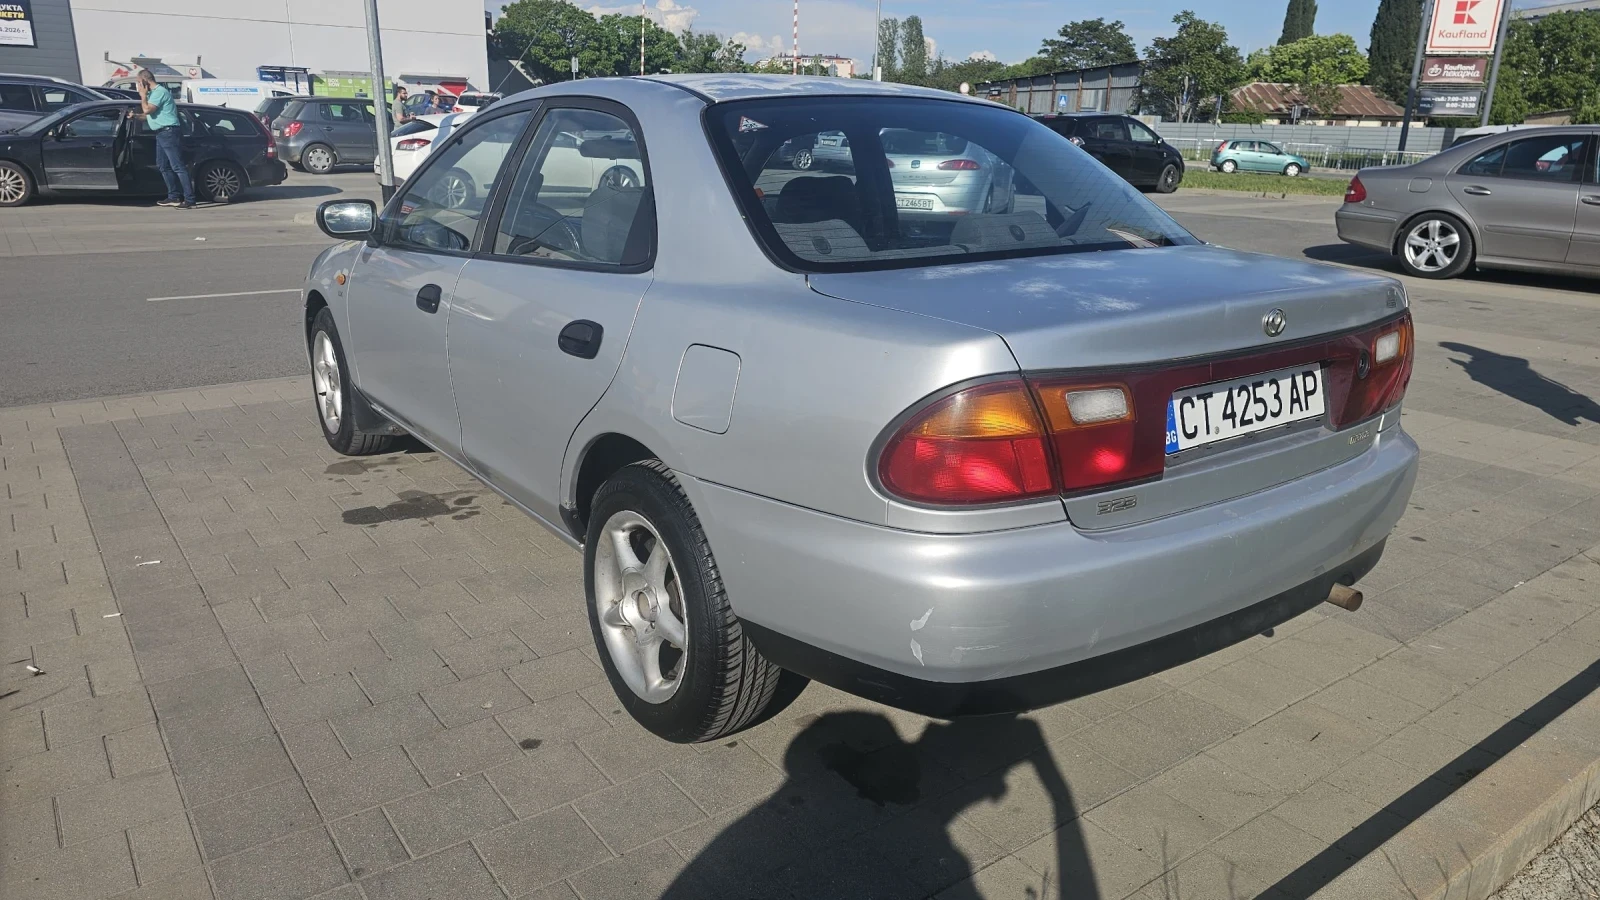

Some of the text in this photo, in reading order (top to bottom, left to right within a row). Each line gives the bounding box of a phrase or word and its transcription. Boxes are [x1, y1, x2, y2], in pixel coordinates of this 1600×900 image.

[1438, 29, 1487, 39] Kaufland
[1442, 70, 1480, 78] пекарна
[1180, 370, 1318, 440] CT 4253 AP
